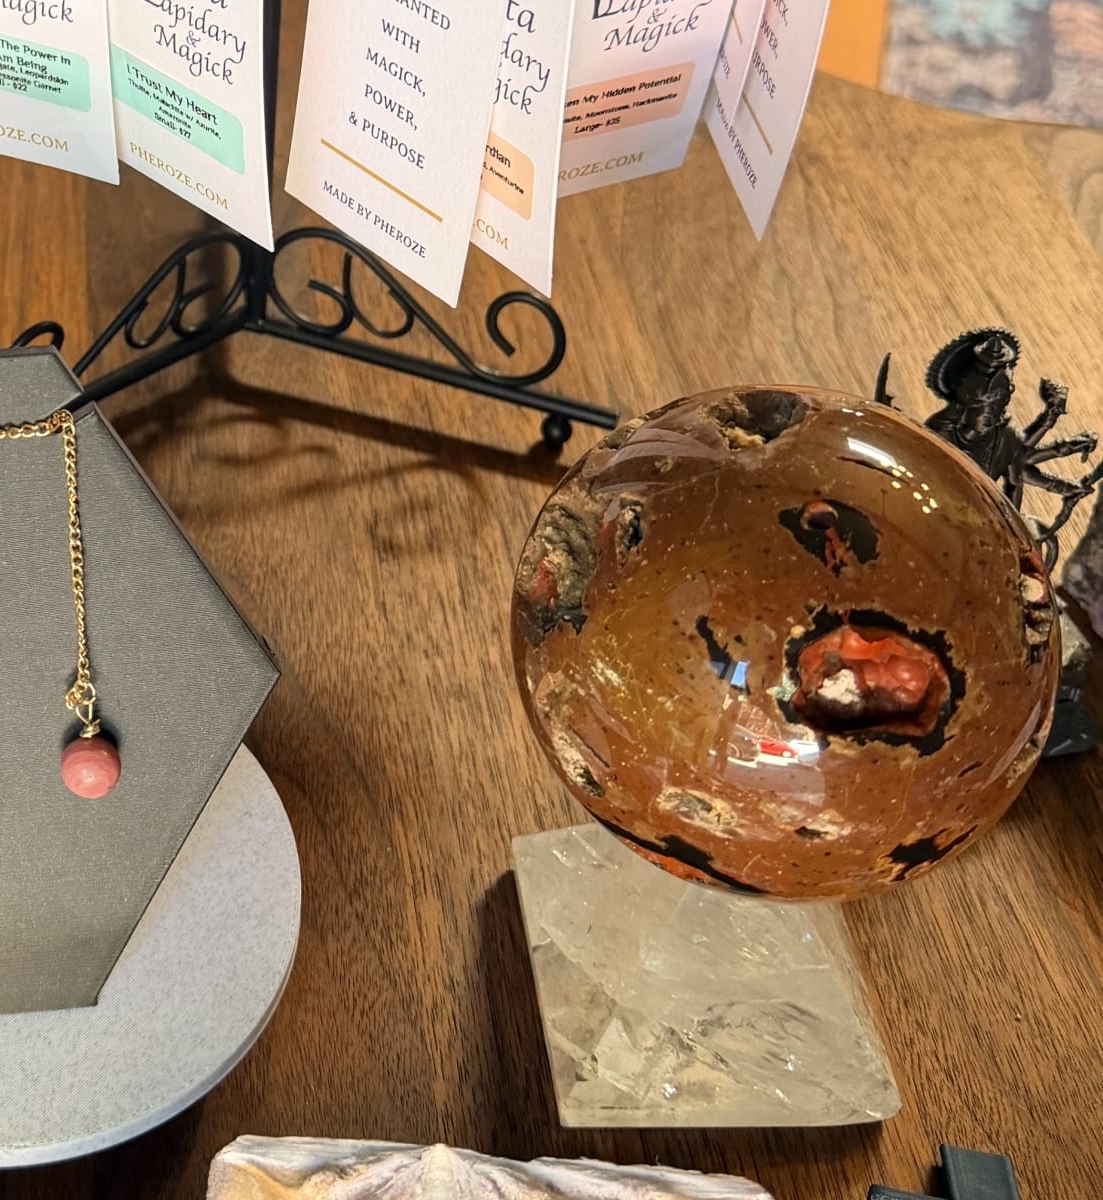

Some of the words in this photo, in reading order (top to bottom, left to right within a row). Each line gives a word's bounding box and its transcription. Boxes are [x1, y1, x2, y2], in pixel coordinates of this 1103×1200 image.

[186, 30, 201, 48] &
[382, 18, 420, 54] WITH
[603, 4, 700, 52] Magick
[647, 8, 667, 24] &
[16, 56, 48, 75] Being
[23, 45, 58, 61] Power
[61, 55, 71, 66] In
[154, 24, 233, 85] Magick
[366, 47, 426, 97] MAGICK,
[752, 48, 776, 100] URPOSE
[33, 80, 62, 94] Garnet
[132, 66, 163, 94] Trust
[165, 85, 183, 106] My
[185, 97, 218, 126] Heart
[364, 83, 418, 131] POWER,
[582, 94, 599, 104] My
[602, 85, 636, 99] Hidden
[638, 74, 682, 90] Potential
[348, 111, 358, 127] &
[362, 118, 426, 169] PURPOSE
[129, 141, 229, 210] PHEROZE.COM
[558, 152, 644, 181] ROZE.COM
[734, 139, 757, 190] PHEROZE
[323, 180, 355, 211] MADE
[356, 203, 372, 220] BY
[373, 214, 427, 258] PHEROZE
